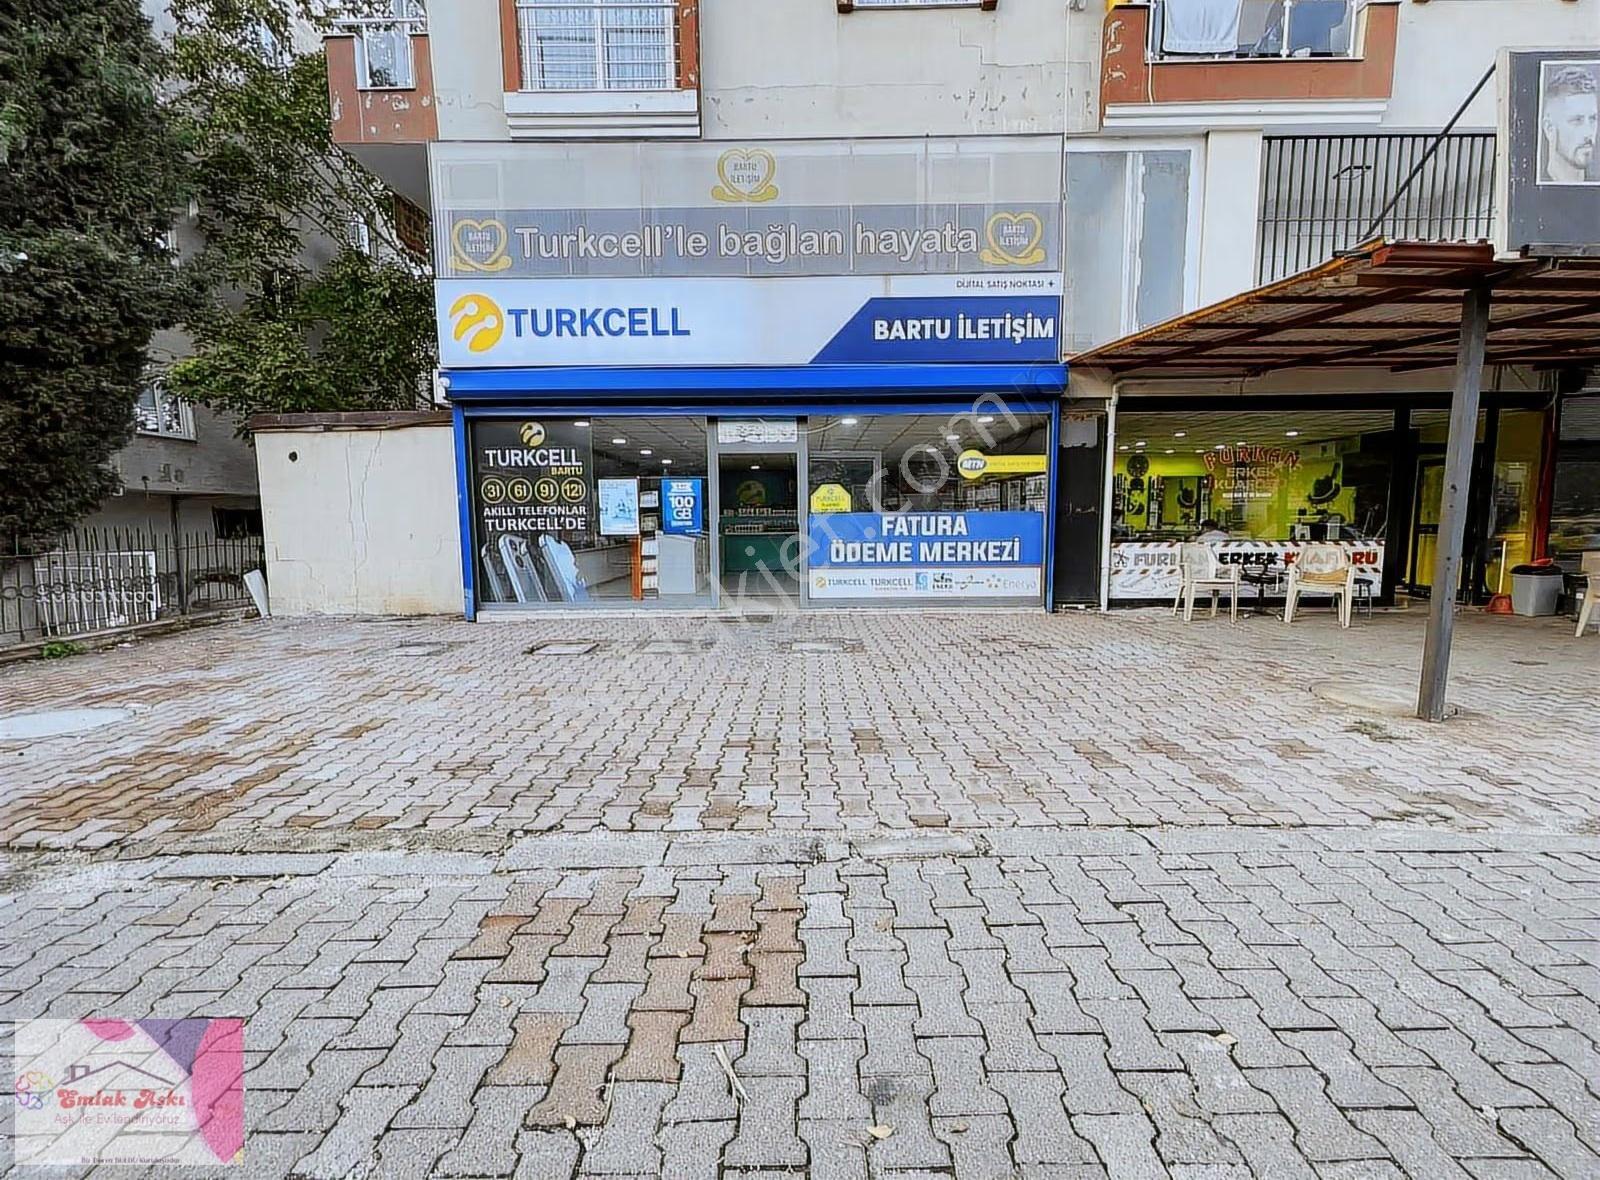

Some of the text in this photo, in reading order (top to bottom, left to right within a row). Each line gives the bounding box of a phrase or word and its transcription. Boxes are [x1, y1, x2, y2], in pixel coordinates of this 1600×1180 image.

[514, 221, 978, 263] Turkcell'le bağlan hayata
[1009, 279, 1045, 288] NOKTASI
[507, 308, 691, 338] TURKCELL
[873, 312, 1055, 344] BARTU İLETİŞİM
[484, 448, 583, 467] TURKCELL
[551, 466, 583, 475] BARTU
[668, 496, 694, 508] 100
[483, 505, 587, 517] AKILLI TELEFONLAR
[673, 507, 692, 520] GB
[484, 517, 587, 532] TURKCELL'DE
[881, 515, 968, 537] FATURA
[830, 537, 1020, 563] ÖDEME MERKEZİ
[1218, 552, 1278, 566] ERKEK
